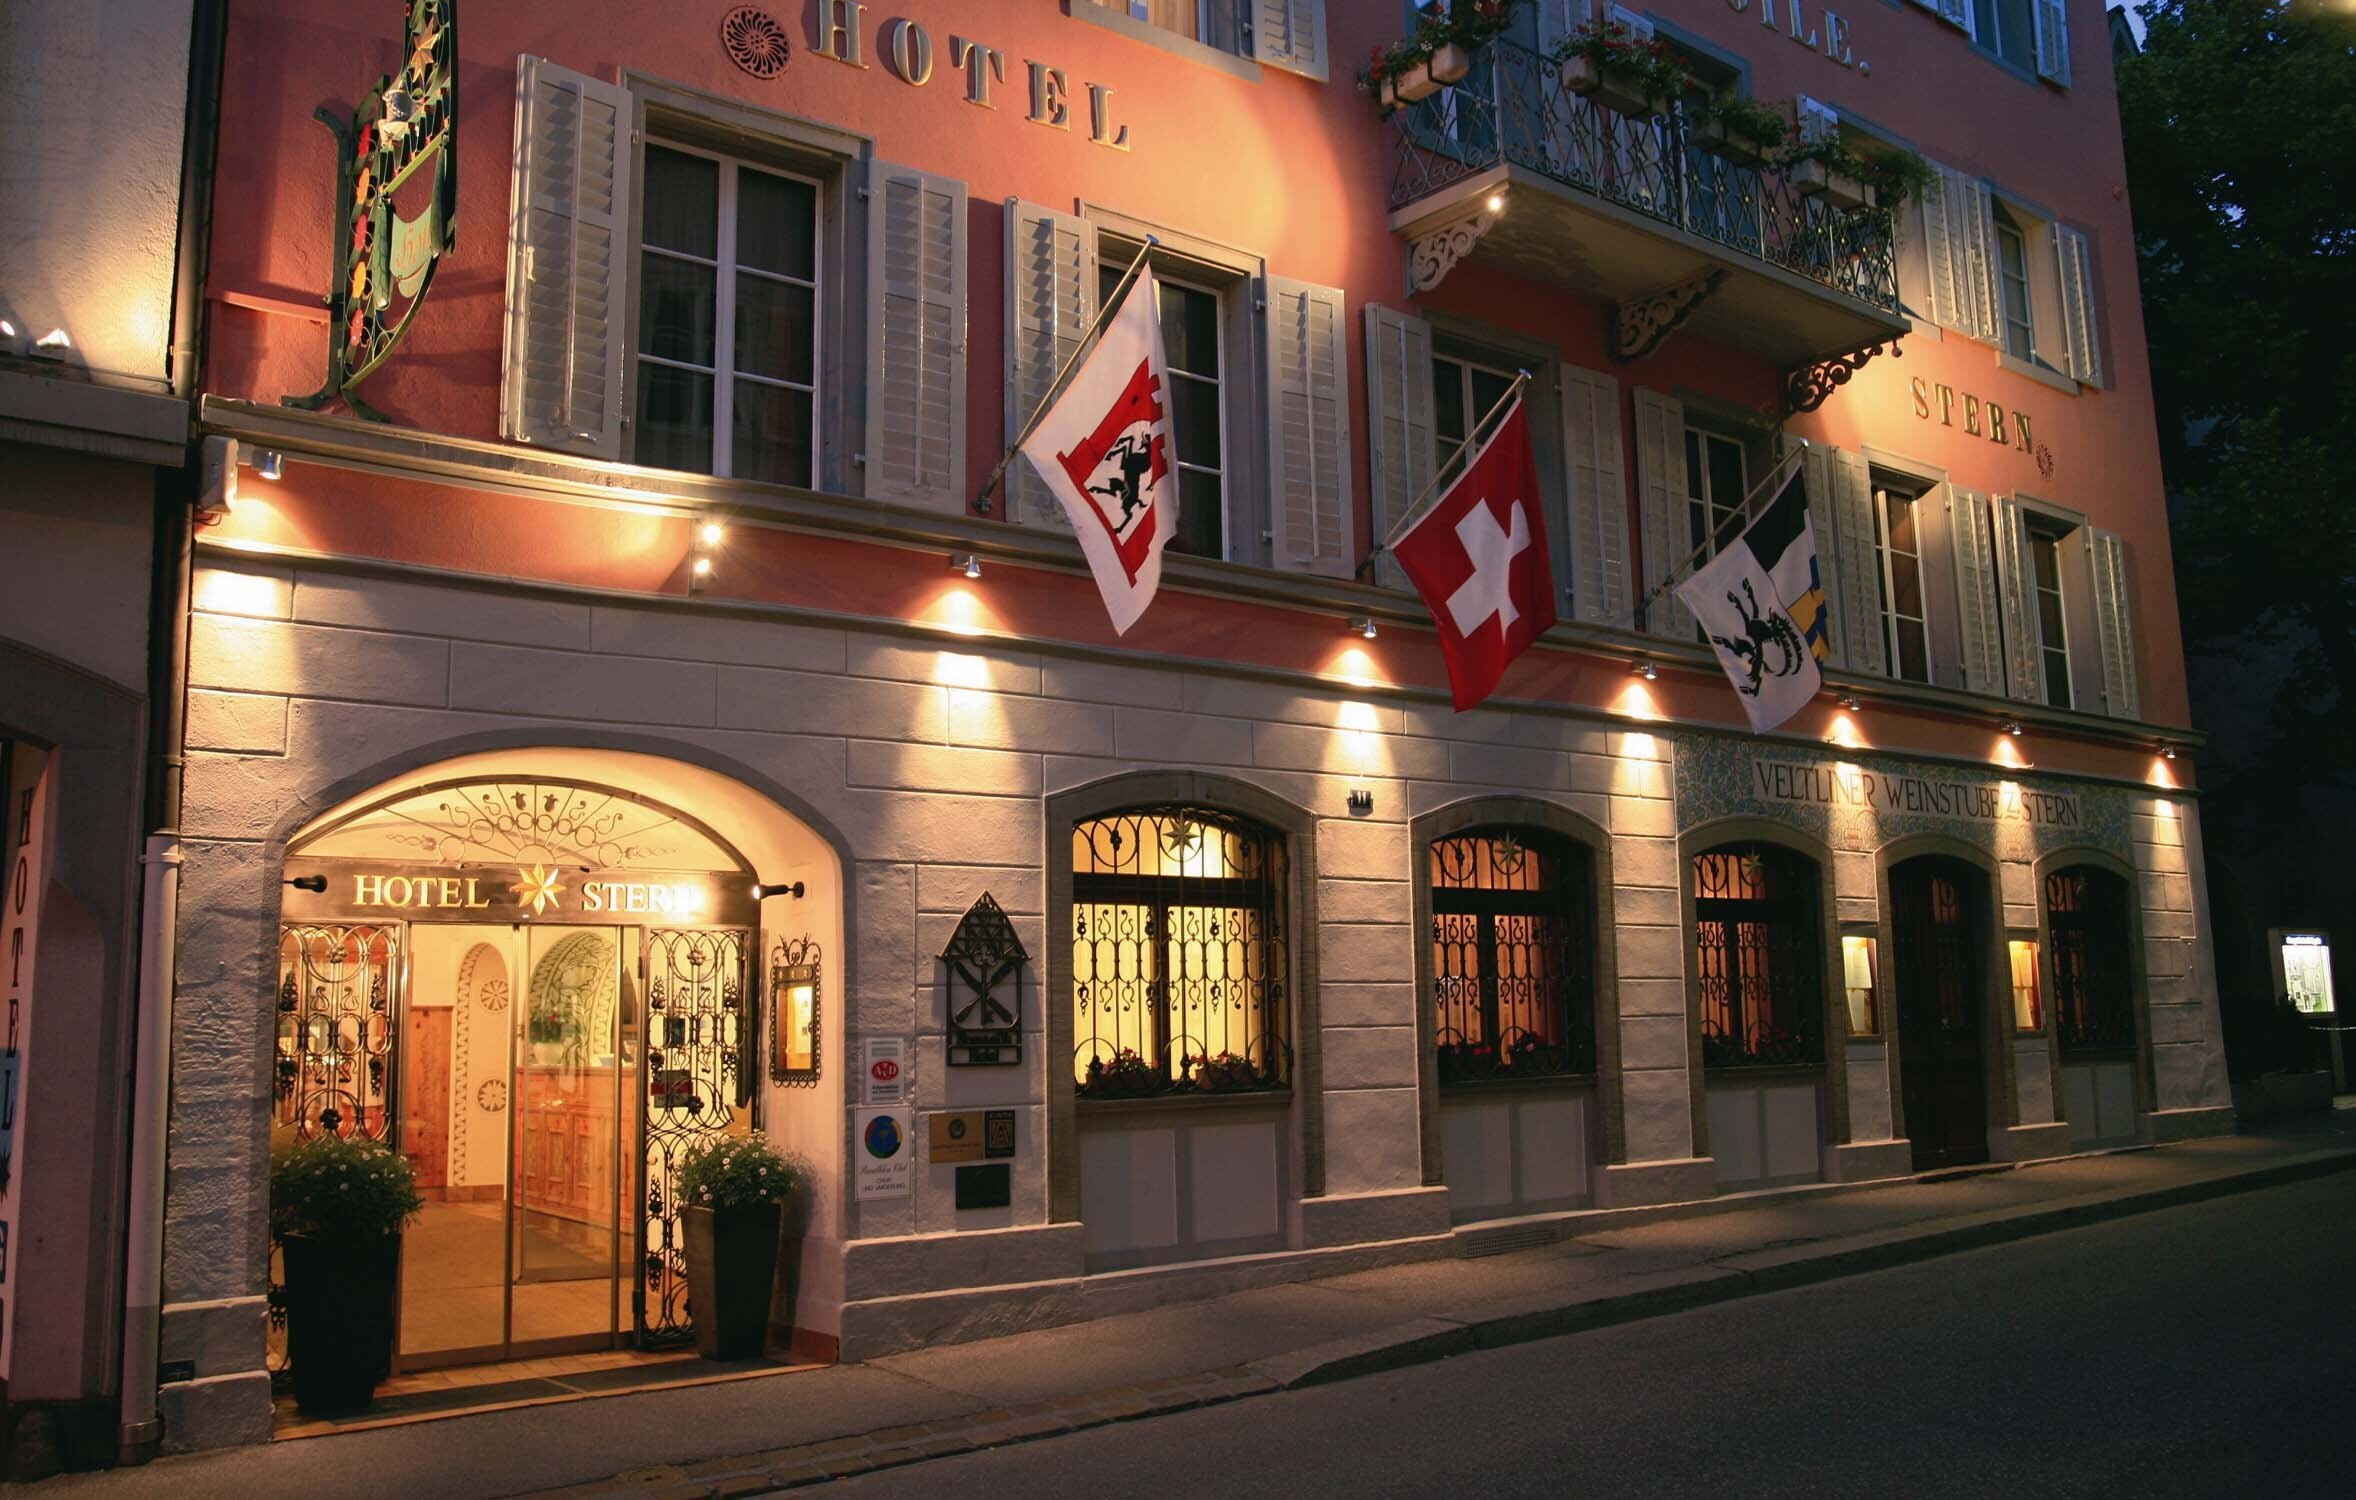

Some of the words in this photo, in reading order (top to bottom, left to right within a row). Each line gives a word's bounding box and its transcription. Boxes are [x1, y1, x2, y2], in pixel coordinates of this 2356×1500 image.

[805, 0, 1130, 152] HOTEL
[1910, 376, 2033, 454] STERN
[1882, 776, 2002, 820] WEINSTUBE
[2021, 791, 2078, 825] STERN
[352, 874, 491, 909] HOTEL
